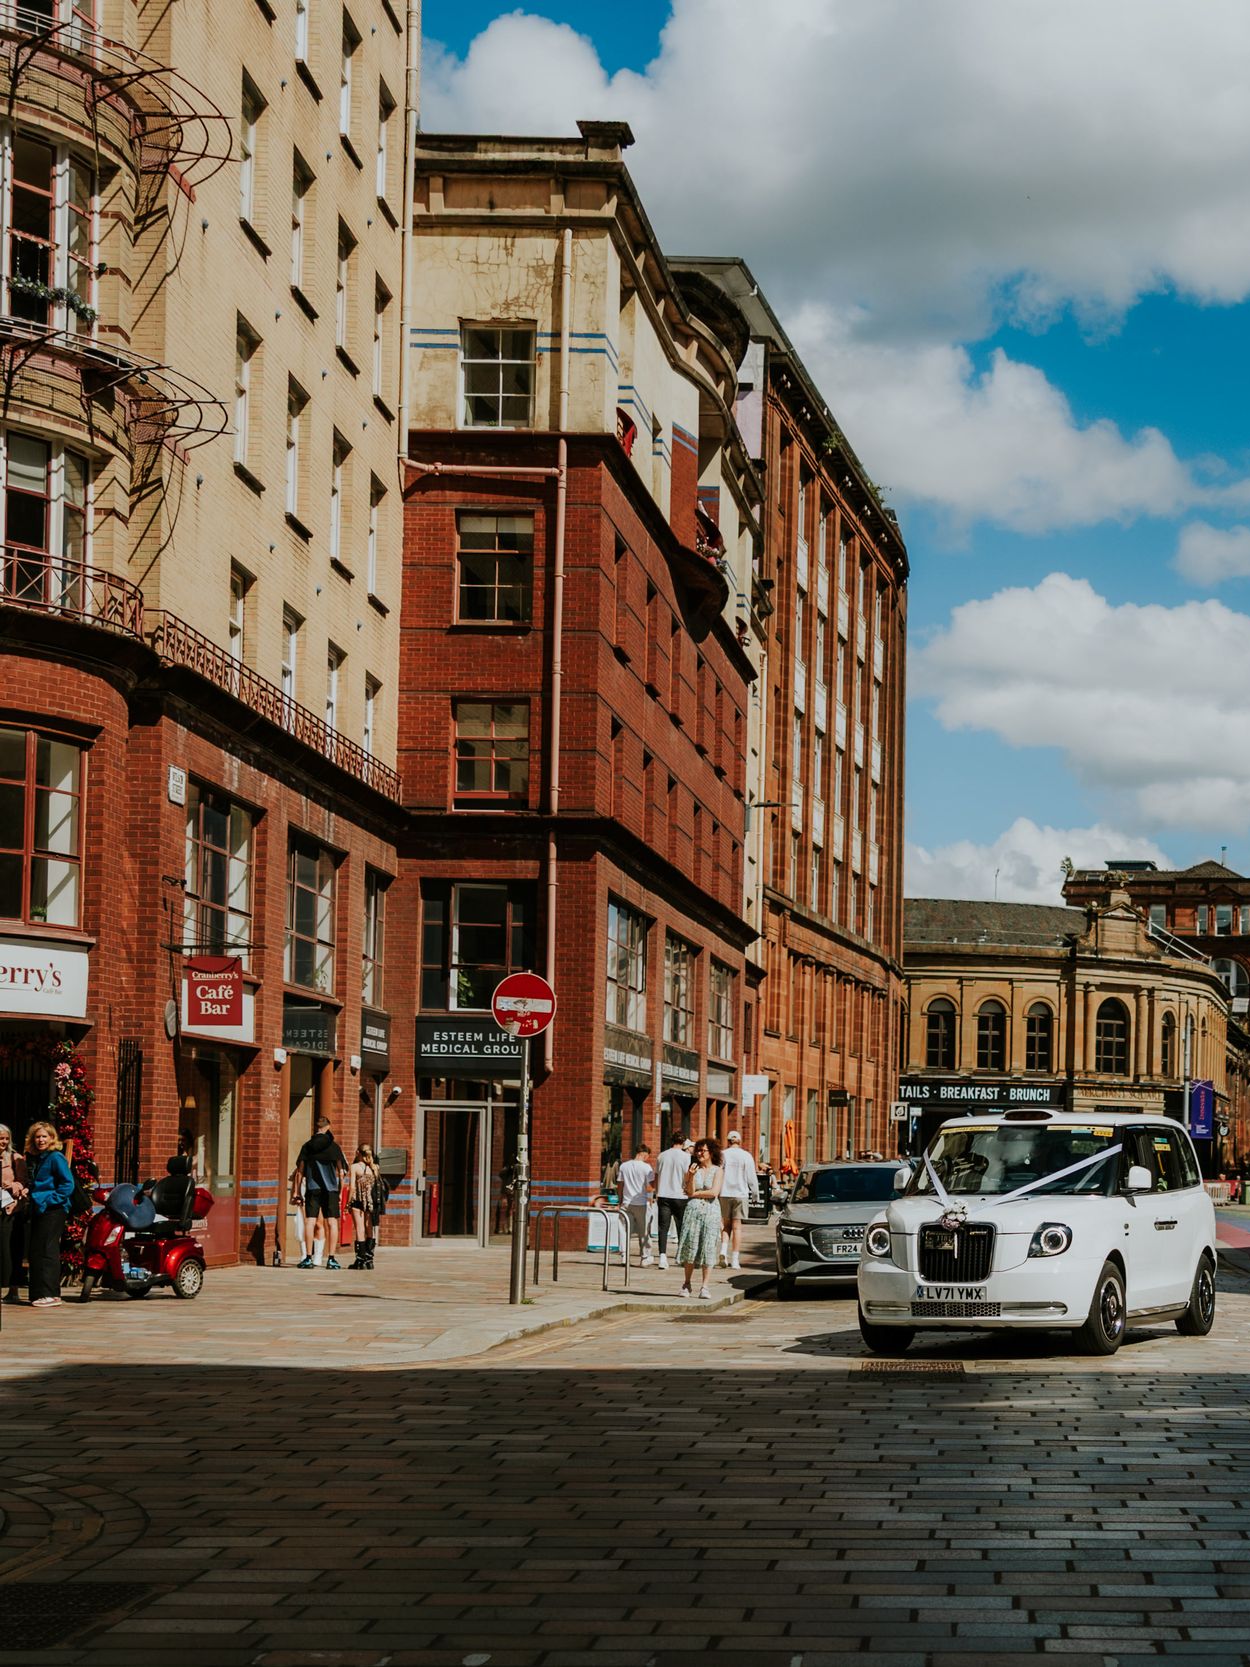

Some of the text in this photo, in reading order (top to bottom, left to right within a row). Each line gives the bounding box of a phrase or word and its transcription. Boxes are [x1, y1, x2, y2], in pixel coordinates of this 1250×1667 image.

[196, 984, 234, 1000] Café
[199, 1000, 231, 1015] Bar
[433, 1031, 516, 1043] ESTEEM LIFE
[421, 1043, 523, 1055] MEDICAL GROU
[900, 1086, 1051, 1102] TAILS BREAKFAST BRUNCH
[836, 1245, 858, 1253] FR24
[926, 1287, 982, 1300] LV71 YMX
